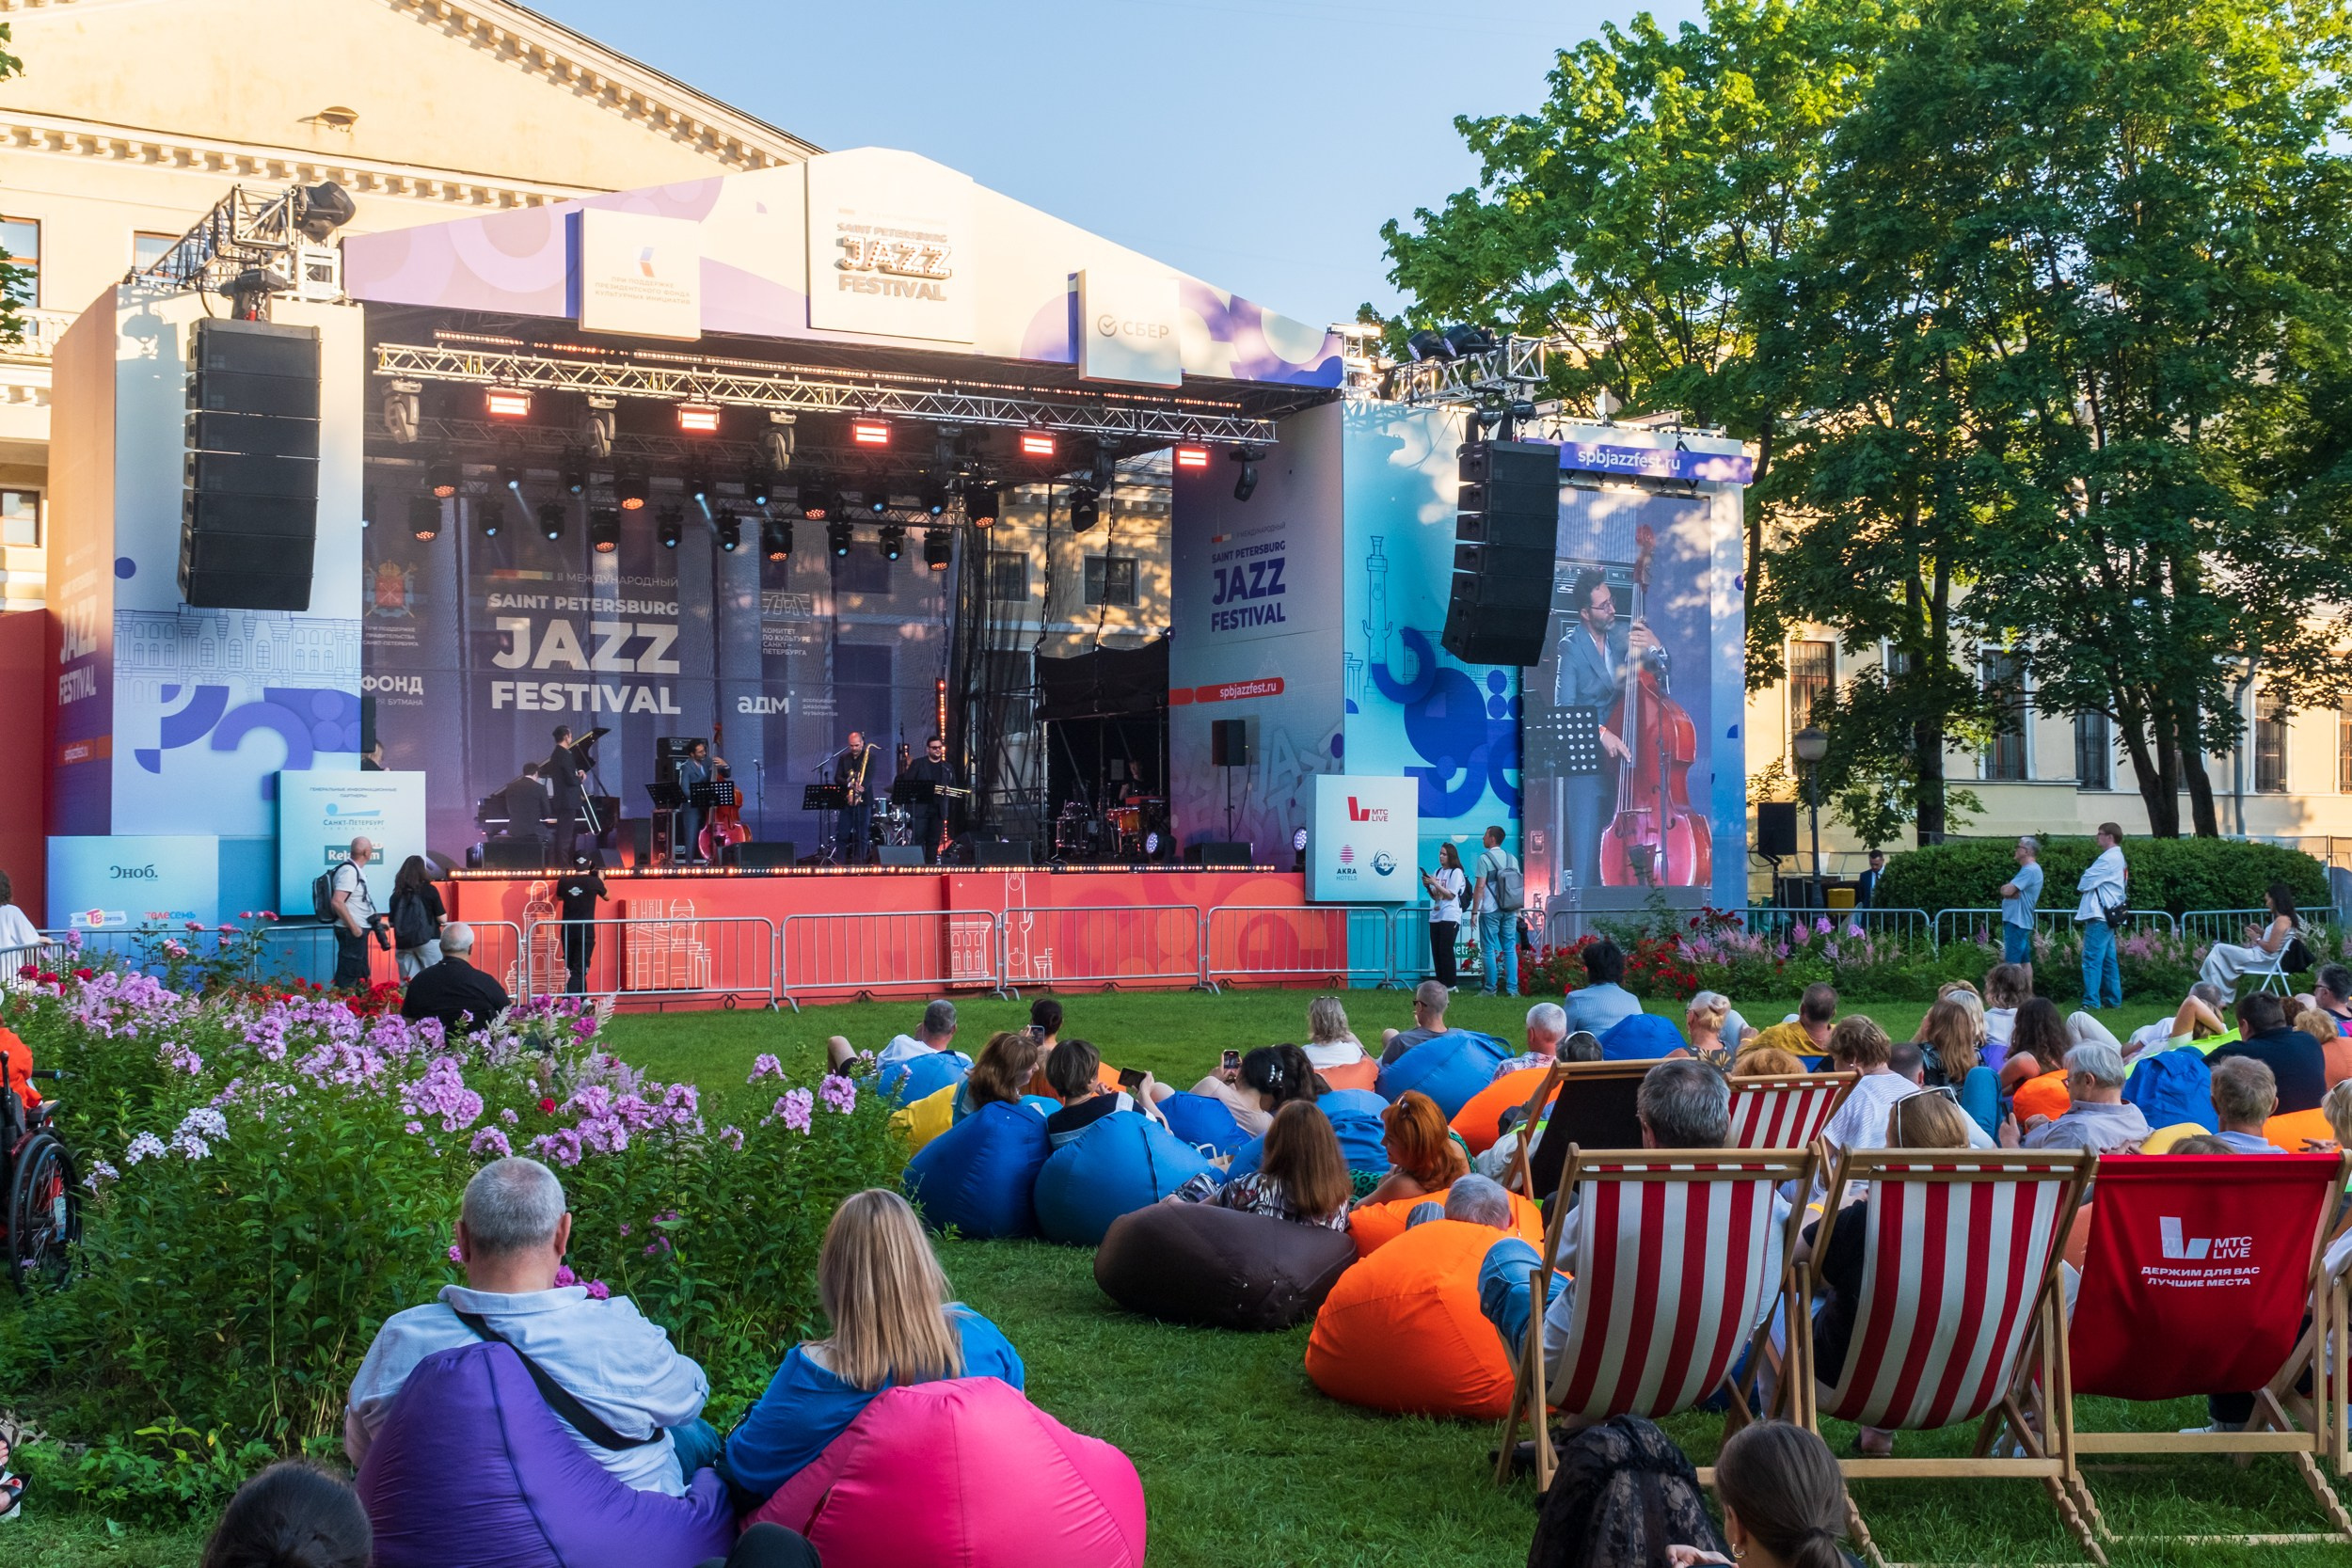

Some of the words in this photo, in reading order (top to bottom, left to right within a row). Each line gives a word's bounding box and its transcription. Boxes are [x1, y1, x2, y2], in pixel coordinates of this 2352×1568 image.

[837, 222, 871, 234] SAINT
[874, 227, 947, 243] PETERSBURG
[834, 235, 952, 280] JAZZ
[838, 274, 946, 301] FESTIVAL
[1123, 322, 1169, 339] СБЕР
[1578, 449, 1680, 470] spbjazzfest.ru
[1212, 549, 1233, 564] SAINT
[1235, 540, 1286, 559] PETERSBURG
[566, 572, 679, 587] МЕЖДУНАРОДНЫЙ
[1212, 557, 1286, 606] JAZZ
[489, 593, 549, 610] SAINT
[555, 595, 679, 615] PETERSBURG
[1212, 602, 1286, 632] FESTIVAL
[60, 594, 98, 664] JAZZ
[762, 626, 796, 635] КОМИТЕТ
[775, 635, 811, 643] КУЛЬТУРЕ
[491, 616, 680, 674] JAZZ
[762, 648, 807, 657] ПЕТЕРБУРГА
[58, 664, 97, 705] FESTIVAL
[361, 675, 423, 694] ФОНД
[1219, 681, 1277, 700] spbjazzfest.ru
[491, 681, 681, 715] FESTIVAL
[2213, 1247, 2251, 1259] LIVE
[2214, 1236, 2253, 1249] МТС
[2141, 1266, 2201, 1276] ДЕРЖИМ
[2203, 1268, 2232, 1277] ДЛЯ
[2233, 1266, 2260, 1275] ВАС
[2147, 1277, 2205, 1287] ЛУЧШИЕ
[2206, 1277, 2250, 1287] МЕСТА
